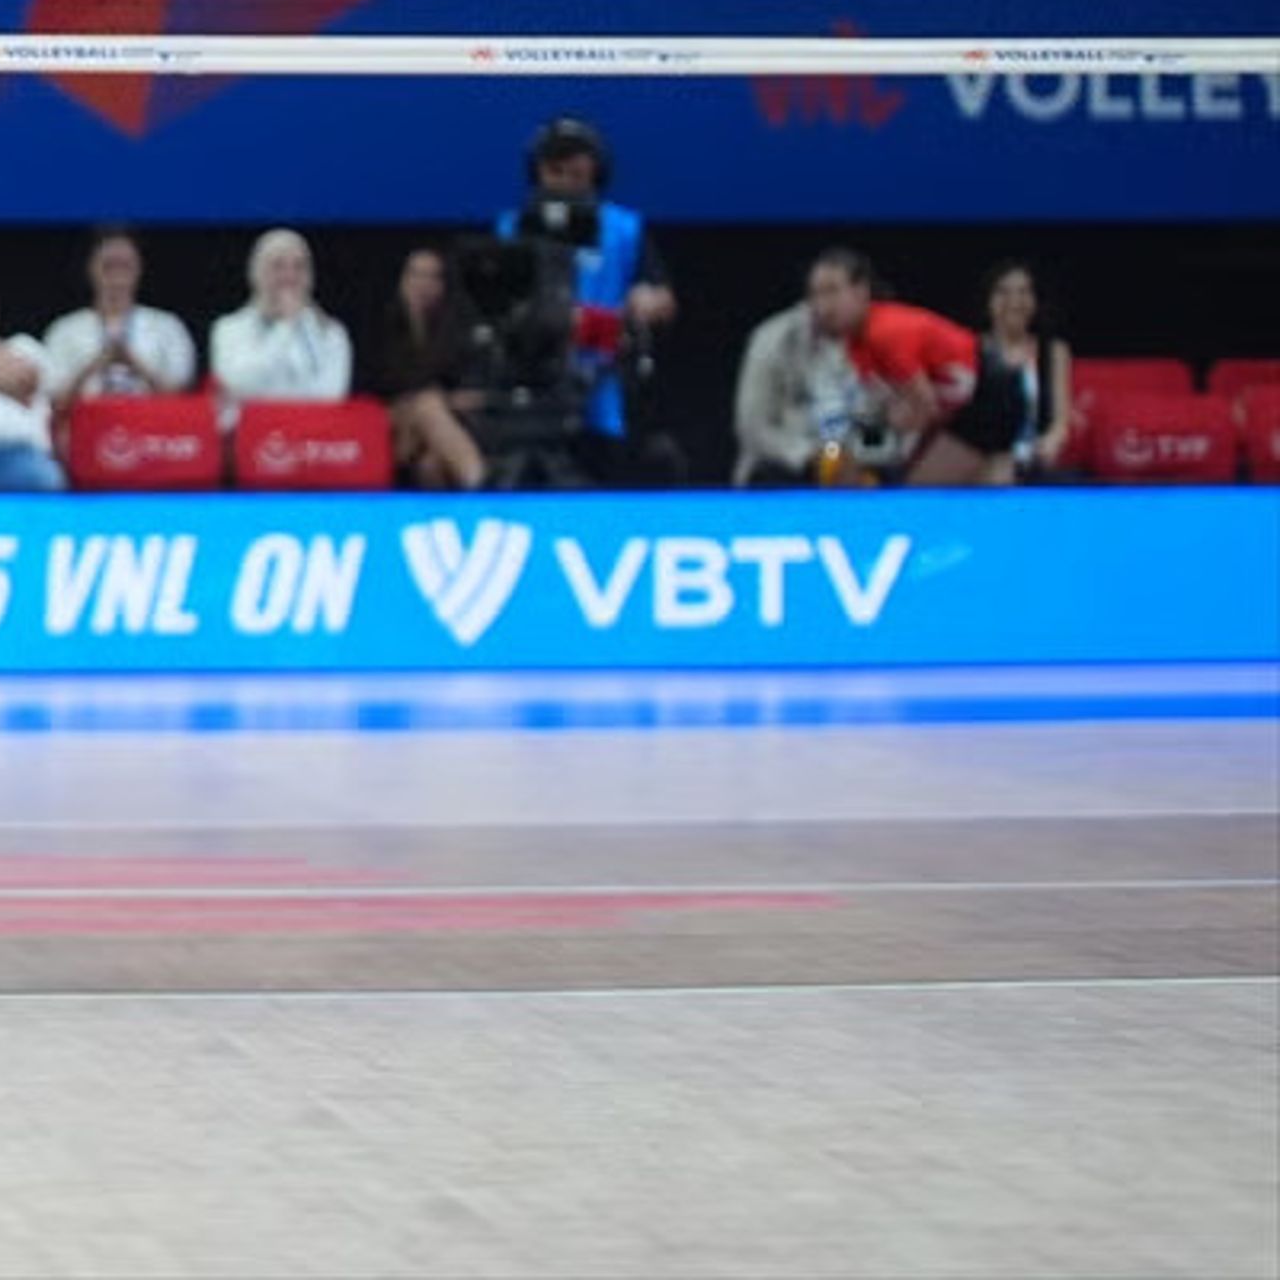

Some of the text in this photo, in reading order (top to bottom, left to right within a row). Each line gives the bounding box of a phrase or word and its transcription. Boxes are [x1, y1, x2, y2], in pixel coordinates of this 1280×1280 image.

[944, 73, 1280, 120] VOLLE
[44, 534, 199, 634] VNL
[230, 533, 367, 633] ON
[553, 535, 910, 627] VBTV
